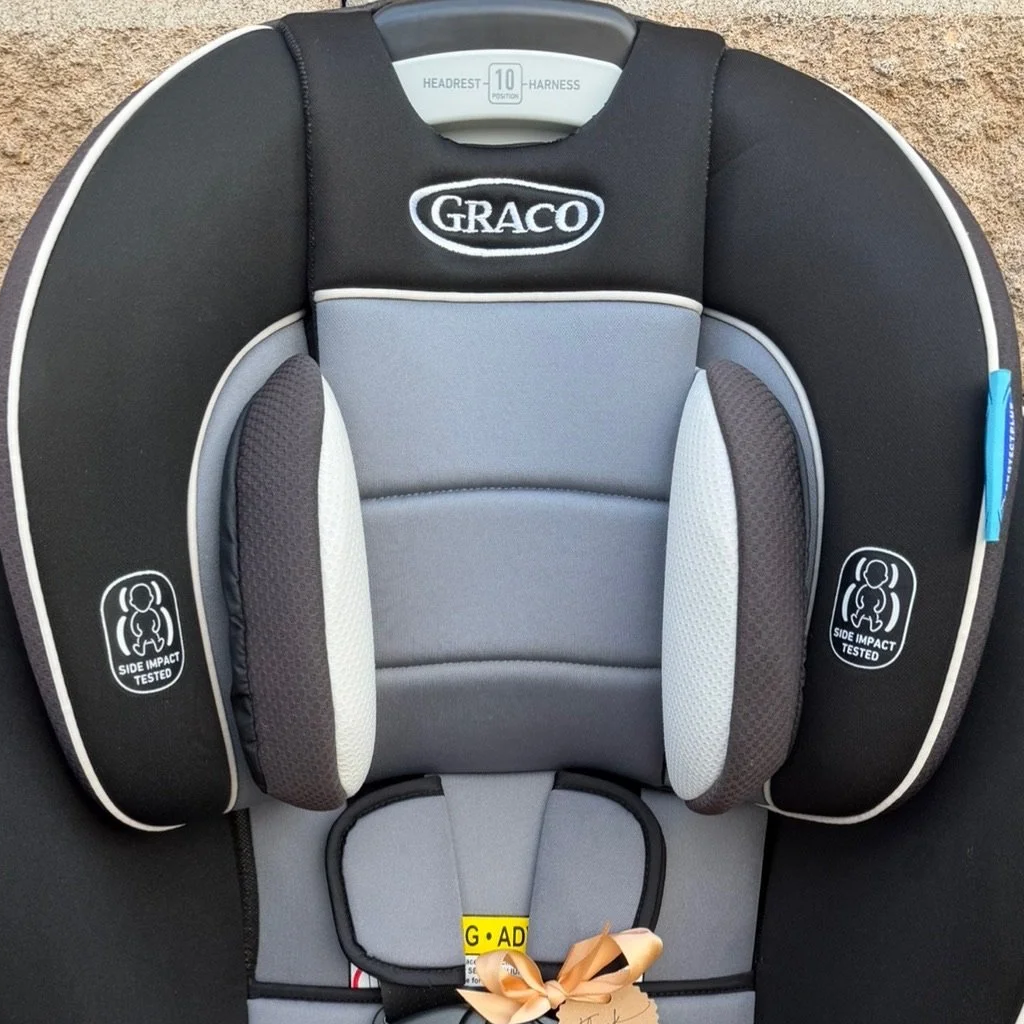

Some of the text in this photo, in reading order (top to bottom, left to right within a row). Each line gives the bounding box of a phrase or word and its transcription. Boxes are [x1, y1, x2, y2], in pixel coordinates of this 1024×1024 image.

[423, 68, 580, 91] HEADREST 10 HARNESS
[492, 92, 519, 100] POSITION
[431, 195, 589, 234] GRACO
[833, 627, 897, 652] SIDE IMPACT
[118, 651, 181, 675] SIDE IMPACT
[841, 642, 880, 662] TESTED
[133, 668, 173, 686] TESTED
[497, 925, 529, 947] AD
